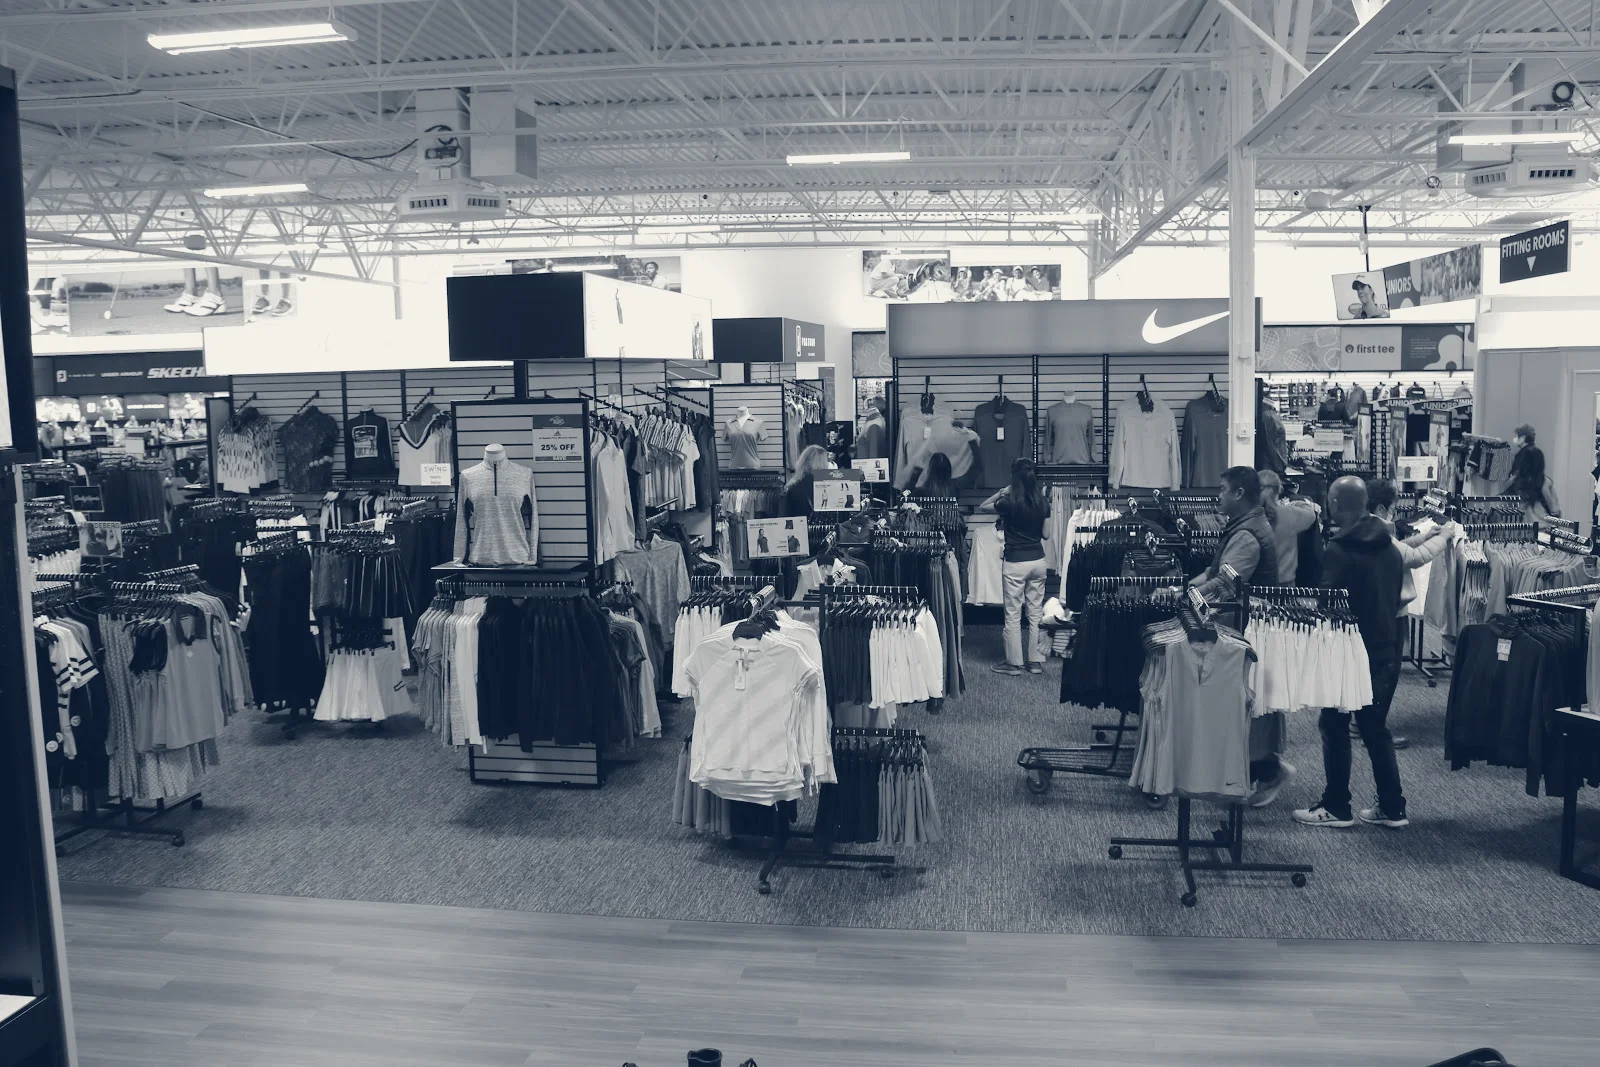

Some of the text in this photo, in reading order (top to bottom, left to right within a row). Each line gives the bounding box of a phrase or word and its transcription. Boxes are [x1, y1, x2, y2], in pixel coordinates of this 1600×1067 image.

[1501, 229, 1565, 259] FITTING ROOMS
[1356, 344, 1395, 354] first tee
[1385, 398, 1421, 407] JUNIO
[541, 443, 576, 451] 25% OFF
